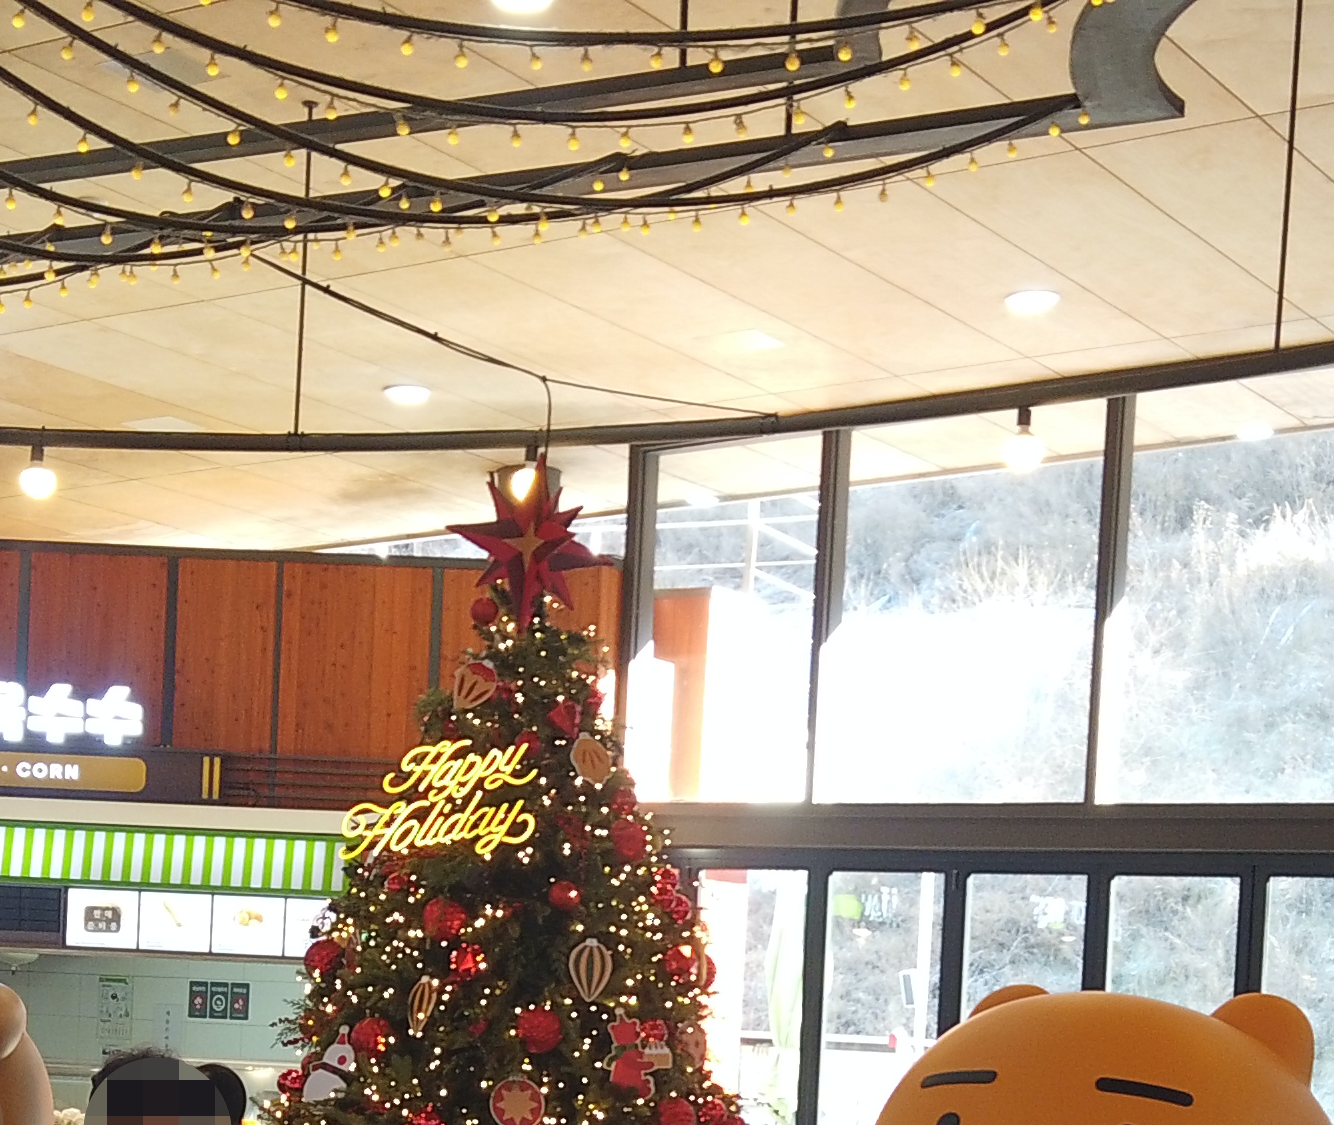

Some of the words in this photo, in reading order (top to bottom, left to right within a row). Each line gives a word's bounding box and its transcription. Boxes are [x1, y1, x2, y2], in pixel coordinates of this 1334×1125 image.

[15, 761, 80, 782] CORN
[382, 739, 539, 802] Happy
[338, 790, 537, 860] Holiday
